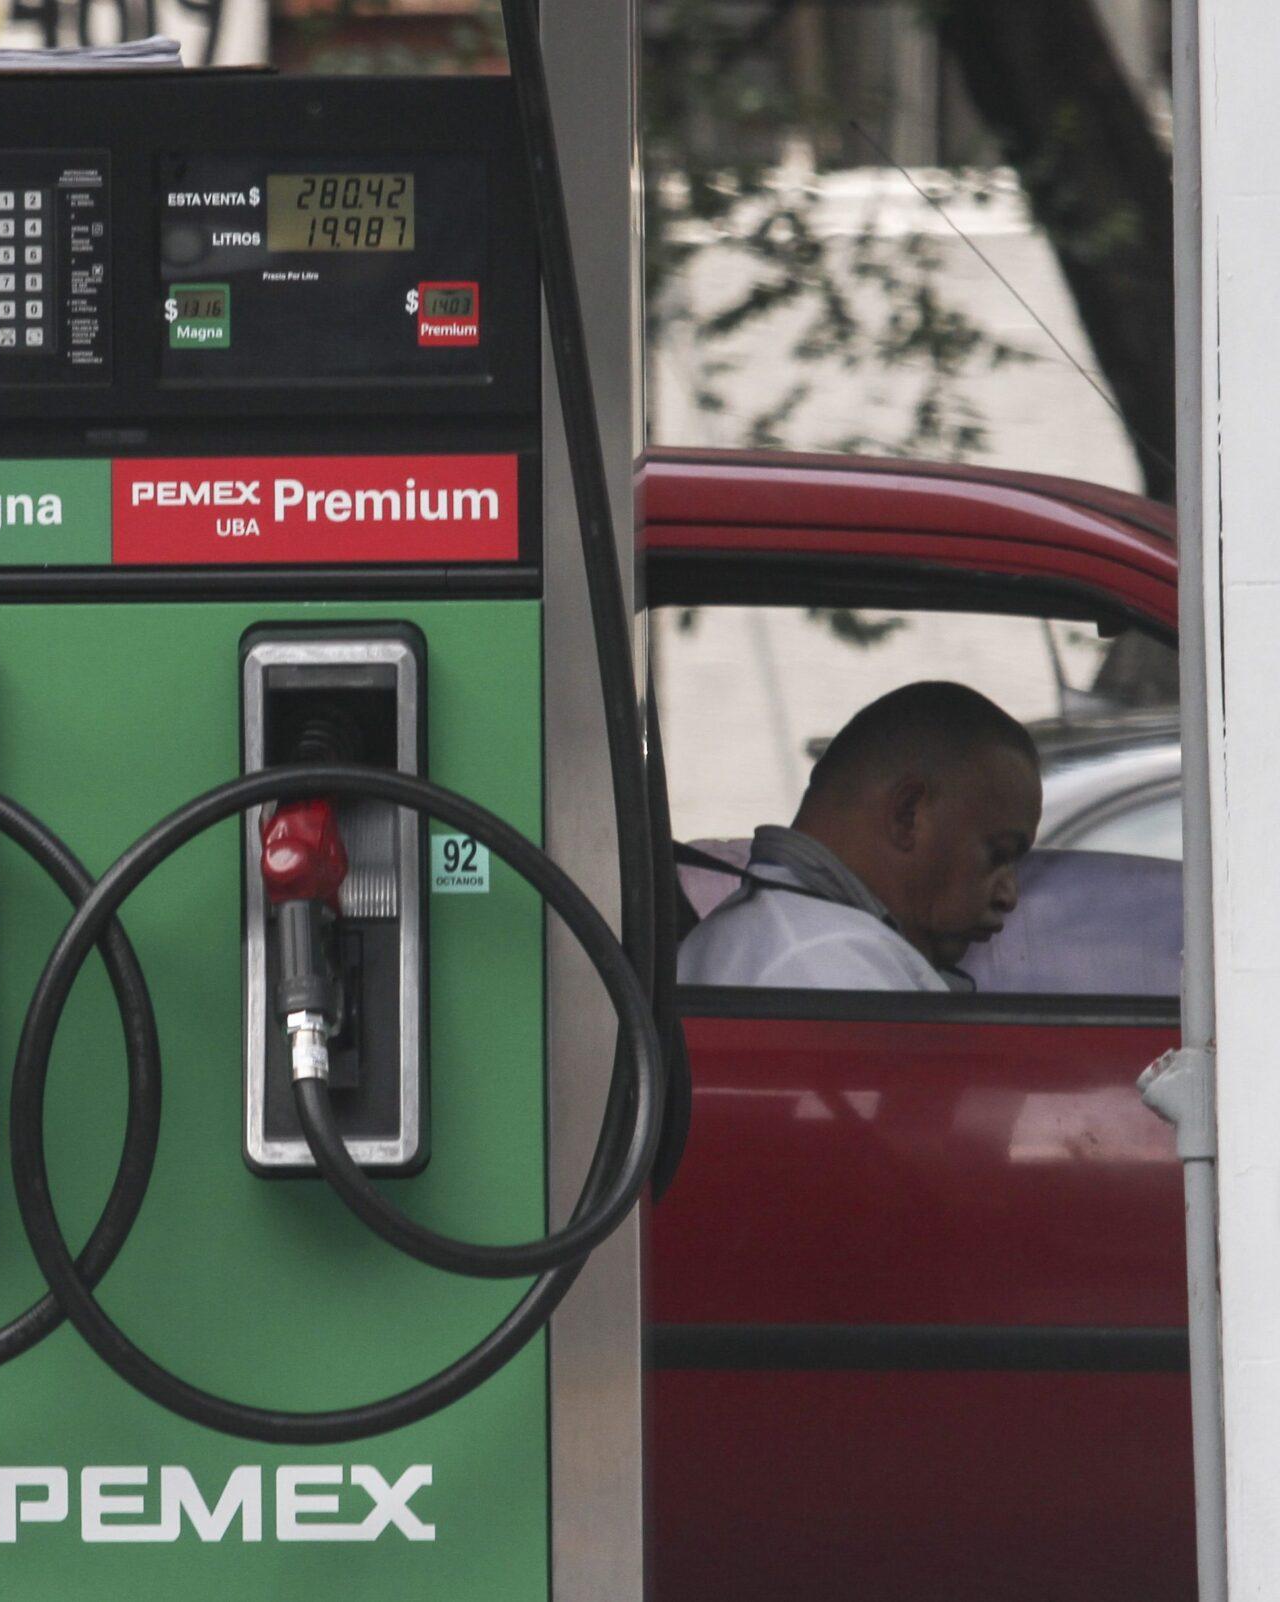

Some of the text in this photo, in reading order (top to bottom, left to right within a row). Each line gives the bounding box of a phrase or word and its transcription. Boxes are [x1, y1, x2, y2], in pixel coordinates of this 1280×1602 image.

[168, 186, 260, 207] ESTA VENTA $
[297, 178, 407, 210] 280.42
[212, 231, 261, 246] LITROS
[308, 216, 407, 248] 19.987
[164, 298, 178, 323] $
[405, 288, 419, 315] $
[176, 325, 223, 342] Magna
[421, 322, 477, 337] Premium
[131, 478, 499, 522] PEMEX Premium
[216, 518, 261, 537] UBA
[443, 839, 478, 873] 92
[435, 876, 484, 886] OCTANOS
